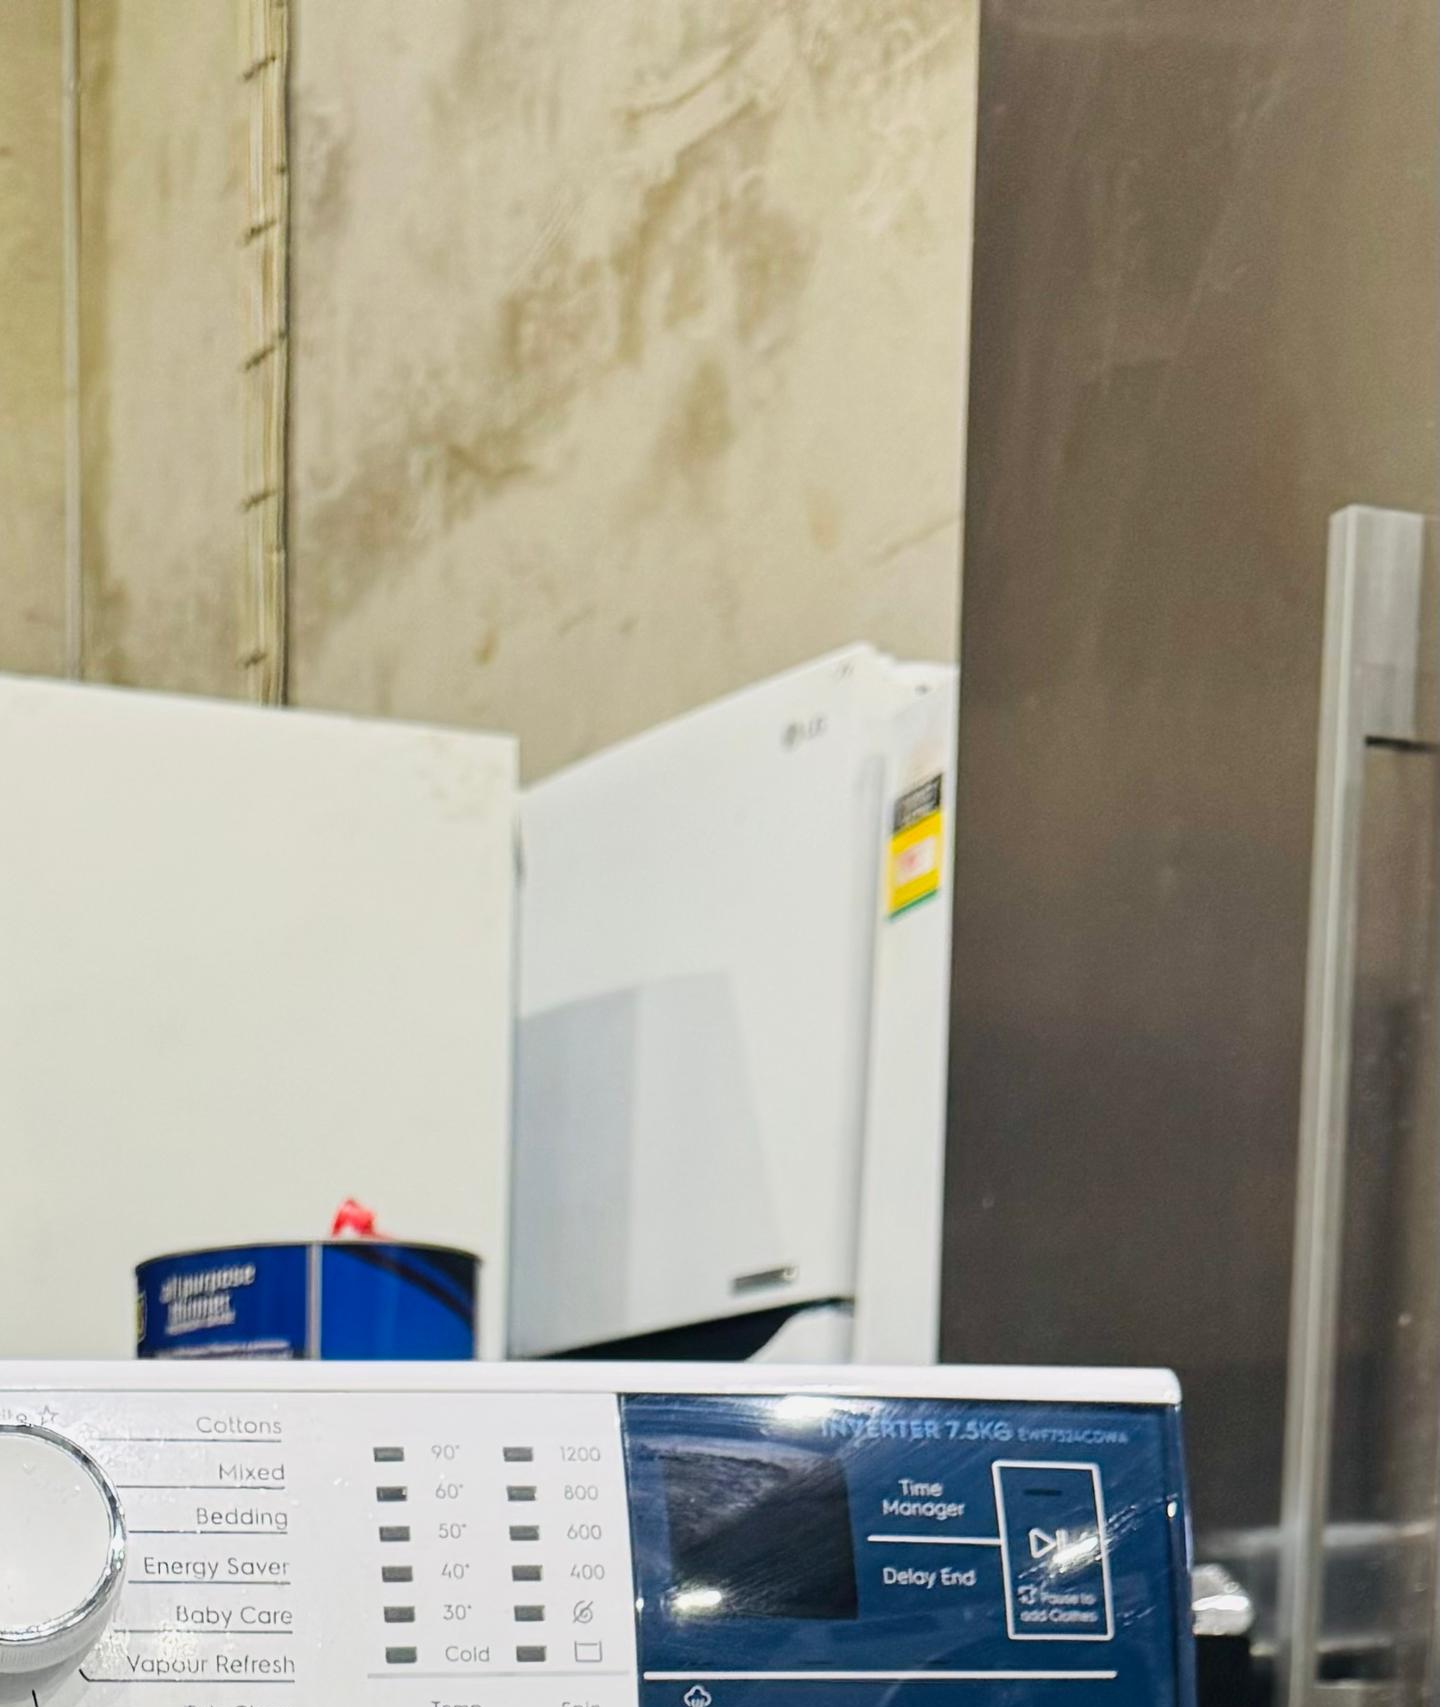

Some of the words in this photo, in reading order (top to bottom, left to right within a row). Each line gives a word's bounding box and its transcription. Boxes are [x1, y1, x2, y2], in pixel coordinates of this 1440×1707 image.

[196, 1416, 282, 1434] Cottons
[821, 1418, 941, 1440] INVERTER
[946, 1420, 1011, 1442] 7.5KG
[560, 1447, 601, 1462] 1200
[219, 1463, 285, 1481] Mixed
[435, 1483, 465, 1500] 60°
[564, 1485, 599, 1501] 800
[898, 1478, 943, 1496] Time
[196, 1507, 288, 1530] Bedding
[882, 1499, 965, 1520] Manager
[438, 1523, 468, 1540] 50°
[567, 1524, 602, 1540] 600
[144, 1556, 219, 1580] Energy
[227, 1557, 290, 1576] Saver
[441, 1562, 471, 1579] 40°
[570, 1564, 605, 1580] 400
[882, 1567, 936, 1589] Delay
[940, 1567, 977, 1586] End
[176, 1605, 232, 1629] Baby
[240, 1606, 293, 1624] Care
[443, 1604, 473, 1621] 30°
[445, 1646, 490, 1663] Cold
[127, 1655, 208, 1676] Vapour
[216, 1654, 295, 1673] Refresh
